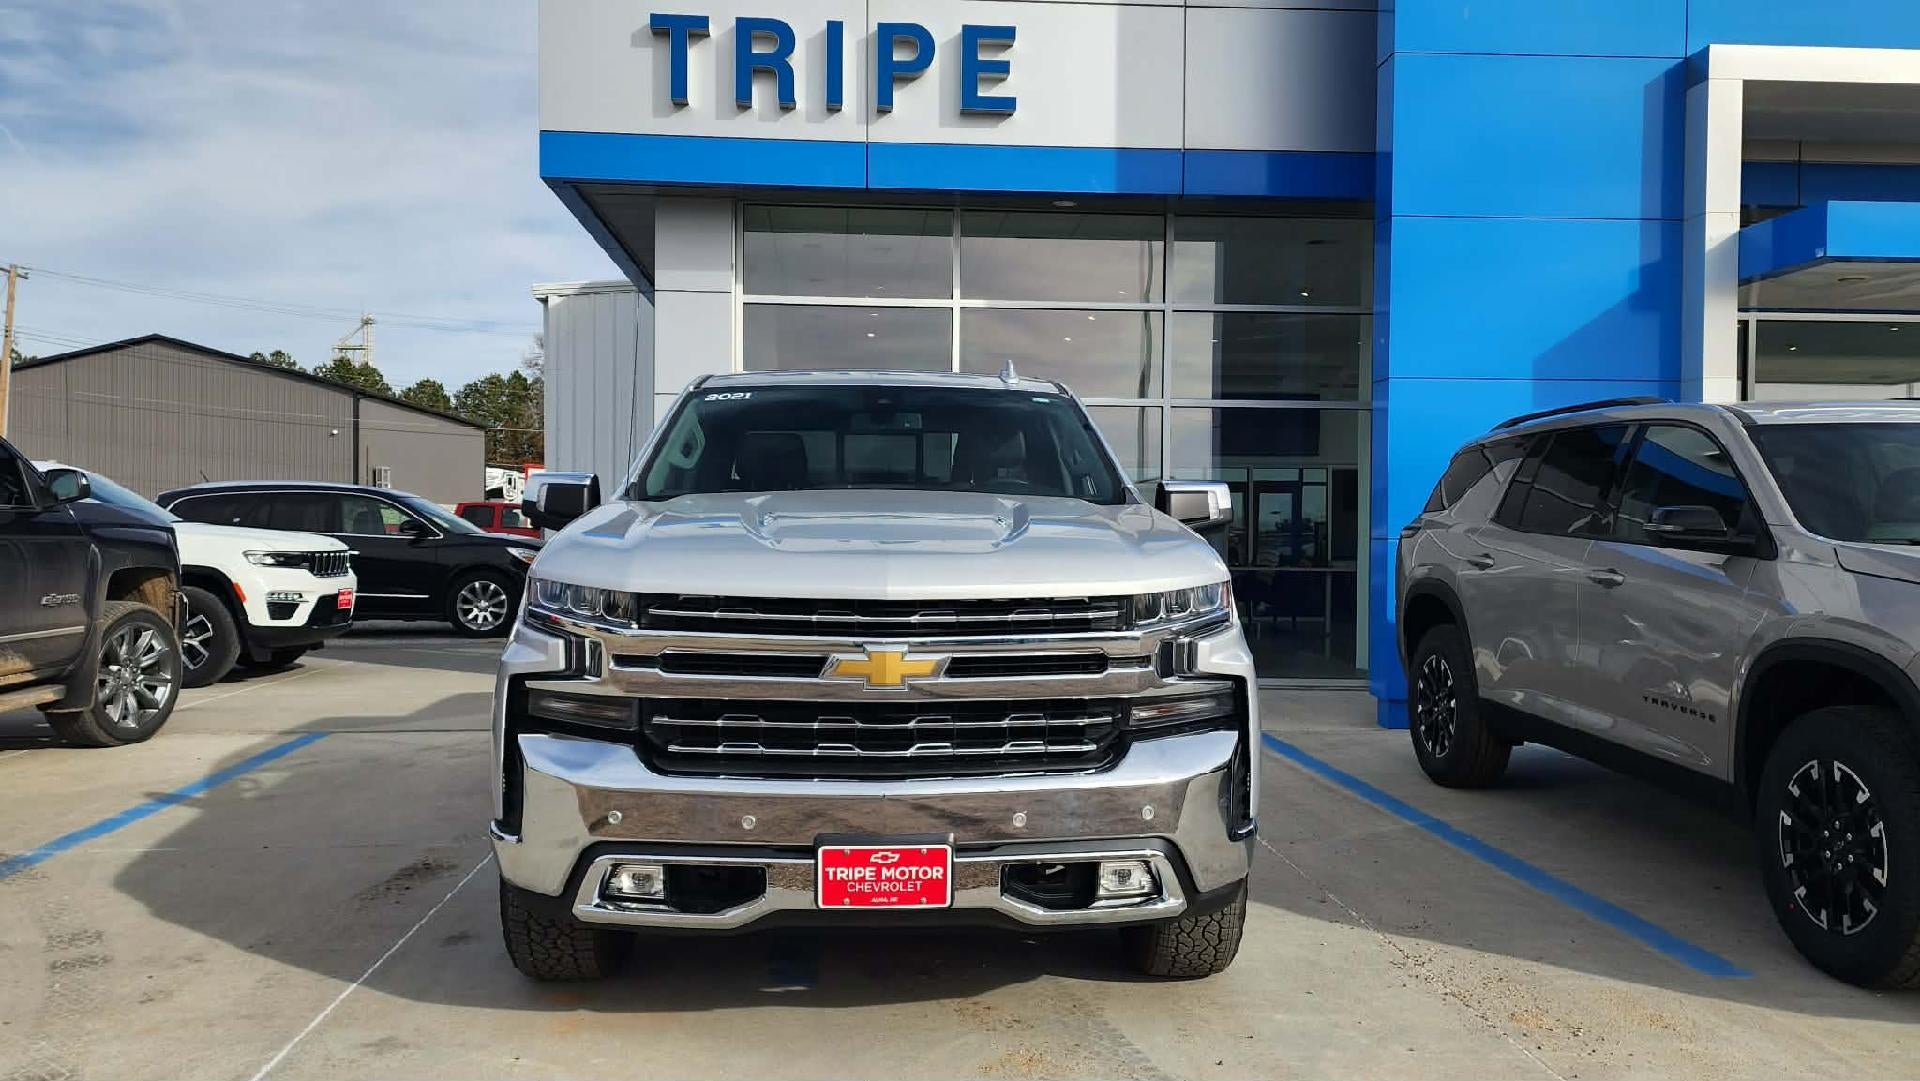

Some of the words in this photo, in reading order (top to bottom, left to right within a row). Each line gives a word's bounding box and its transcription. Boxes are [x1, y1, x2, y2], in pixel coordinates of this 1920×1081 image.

[649, 12, 1017, 116] TRIPE
[704, 392, 752, 401] 2021
[825, 866, 877, 881] TRIPE
[881, 866, 944, 880] MOTOR
[847, 881, 923, 893] CHEVROLET
